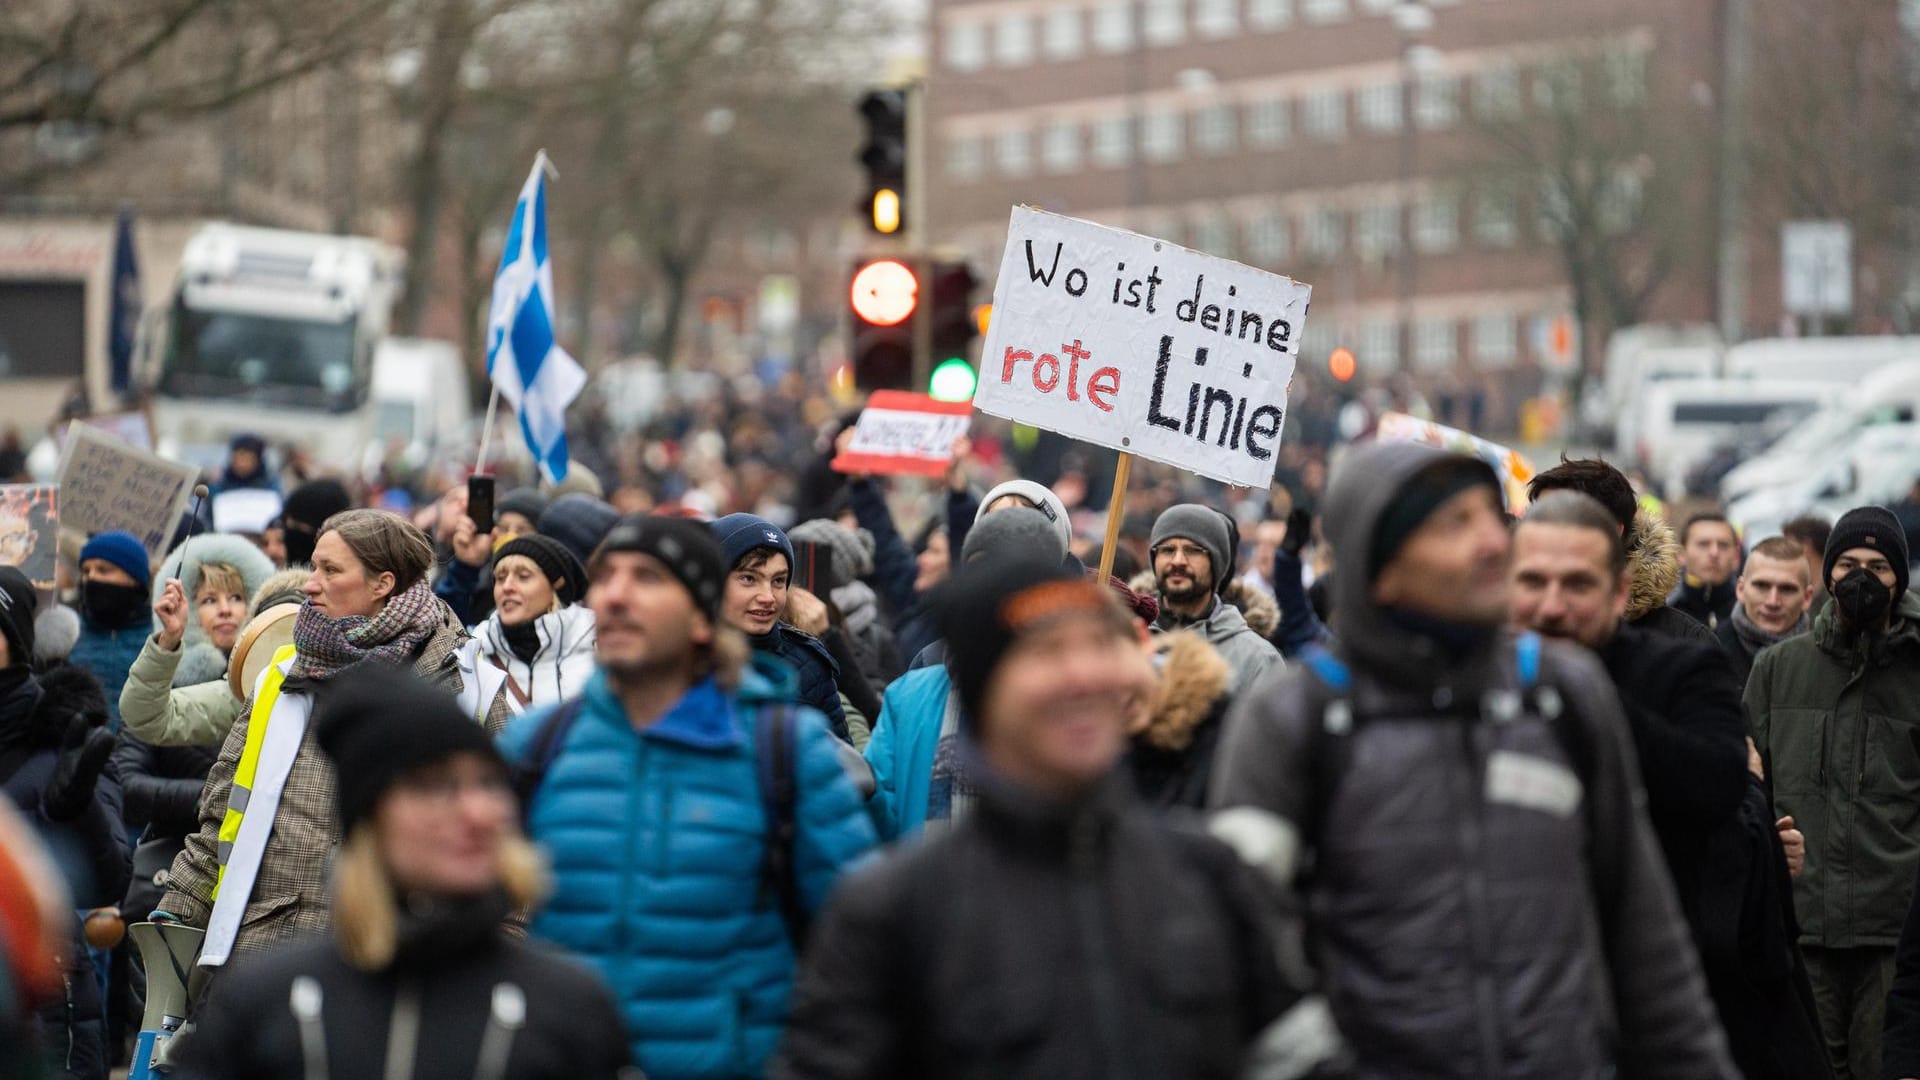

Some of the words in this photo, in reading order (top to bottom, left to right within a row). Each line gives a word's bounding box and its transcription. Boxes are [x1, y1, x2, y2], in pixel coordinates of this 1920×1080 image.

[1025, 239, 1088, 297] Wo
[1112, 262, 1162, 314] ist
[1176, 273, 1291, 352] deine
[1001, 339, 1121, 413] rote
[1147, 334, 1283, 461] Linie
